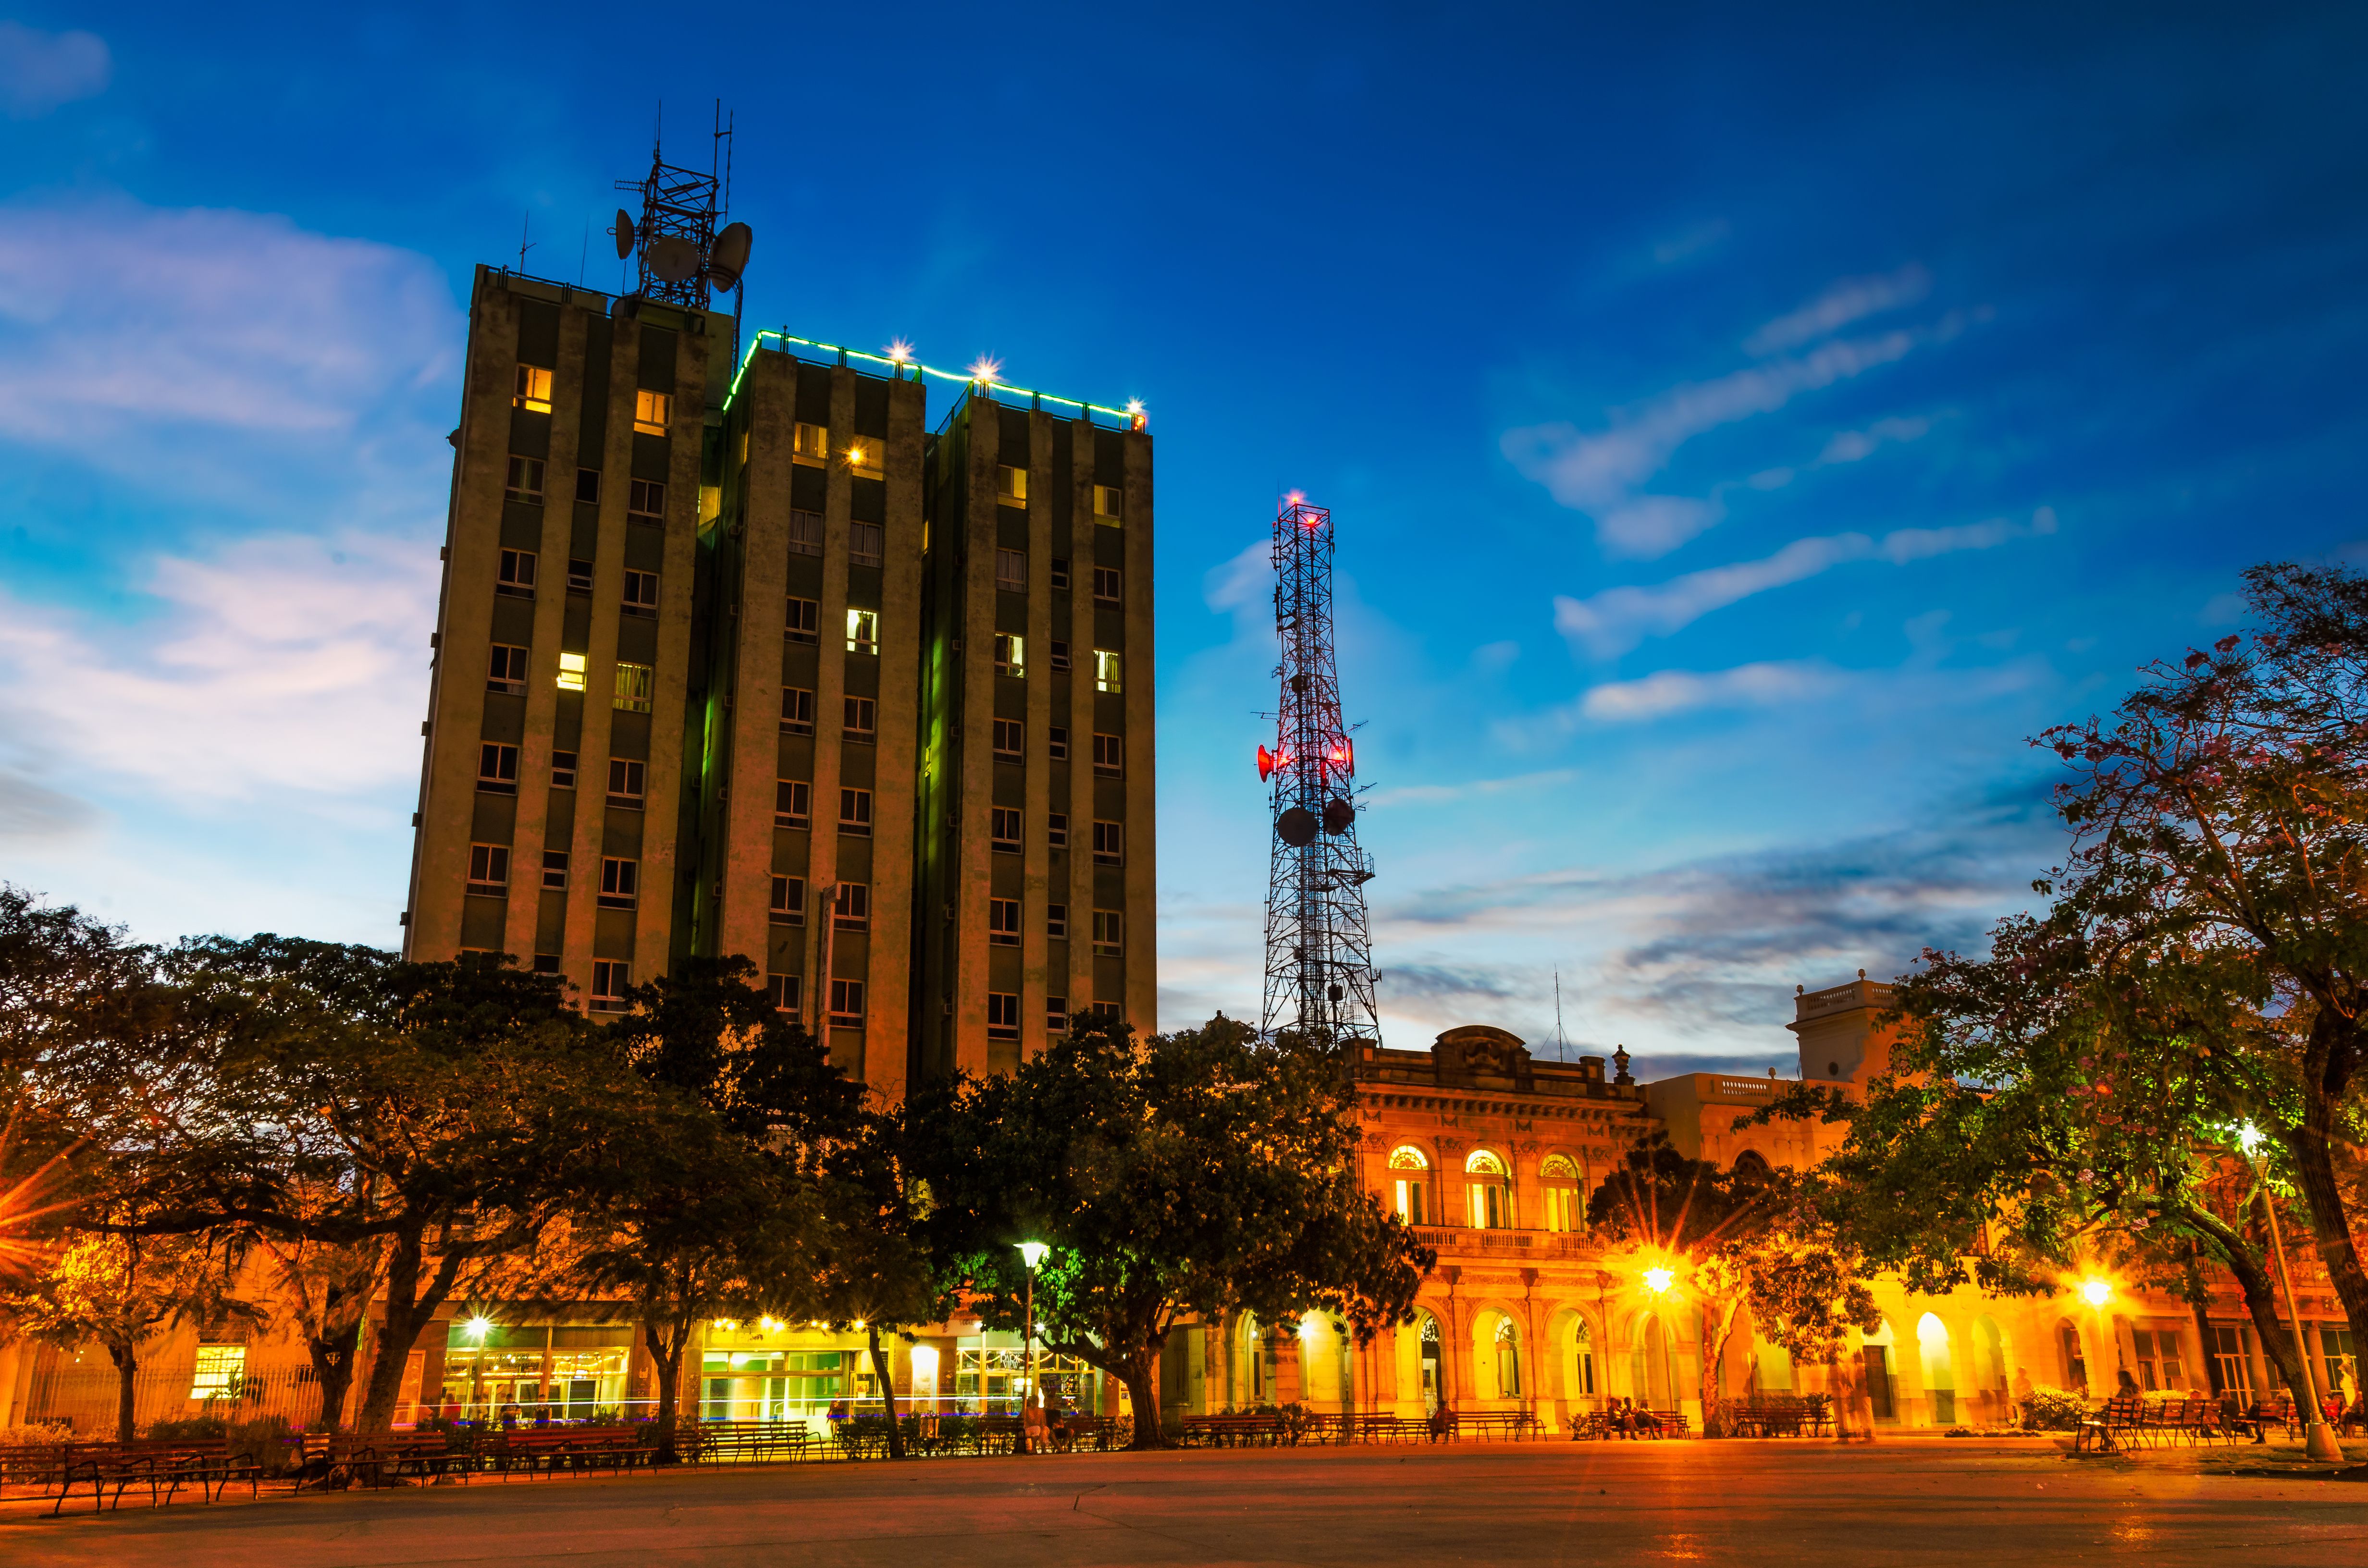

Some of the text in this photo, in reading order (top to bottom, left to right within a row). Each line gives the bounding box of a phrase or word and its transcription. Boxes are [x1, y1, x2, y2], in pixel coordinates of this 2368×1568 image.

[737, 1332, 776, 1344] CAO
[1000, 1352, 1021, 1363] PARK
[1002, 1360, 1018, 1369] VIEW
